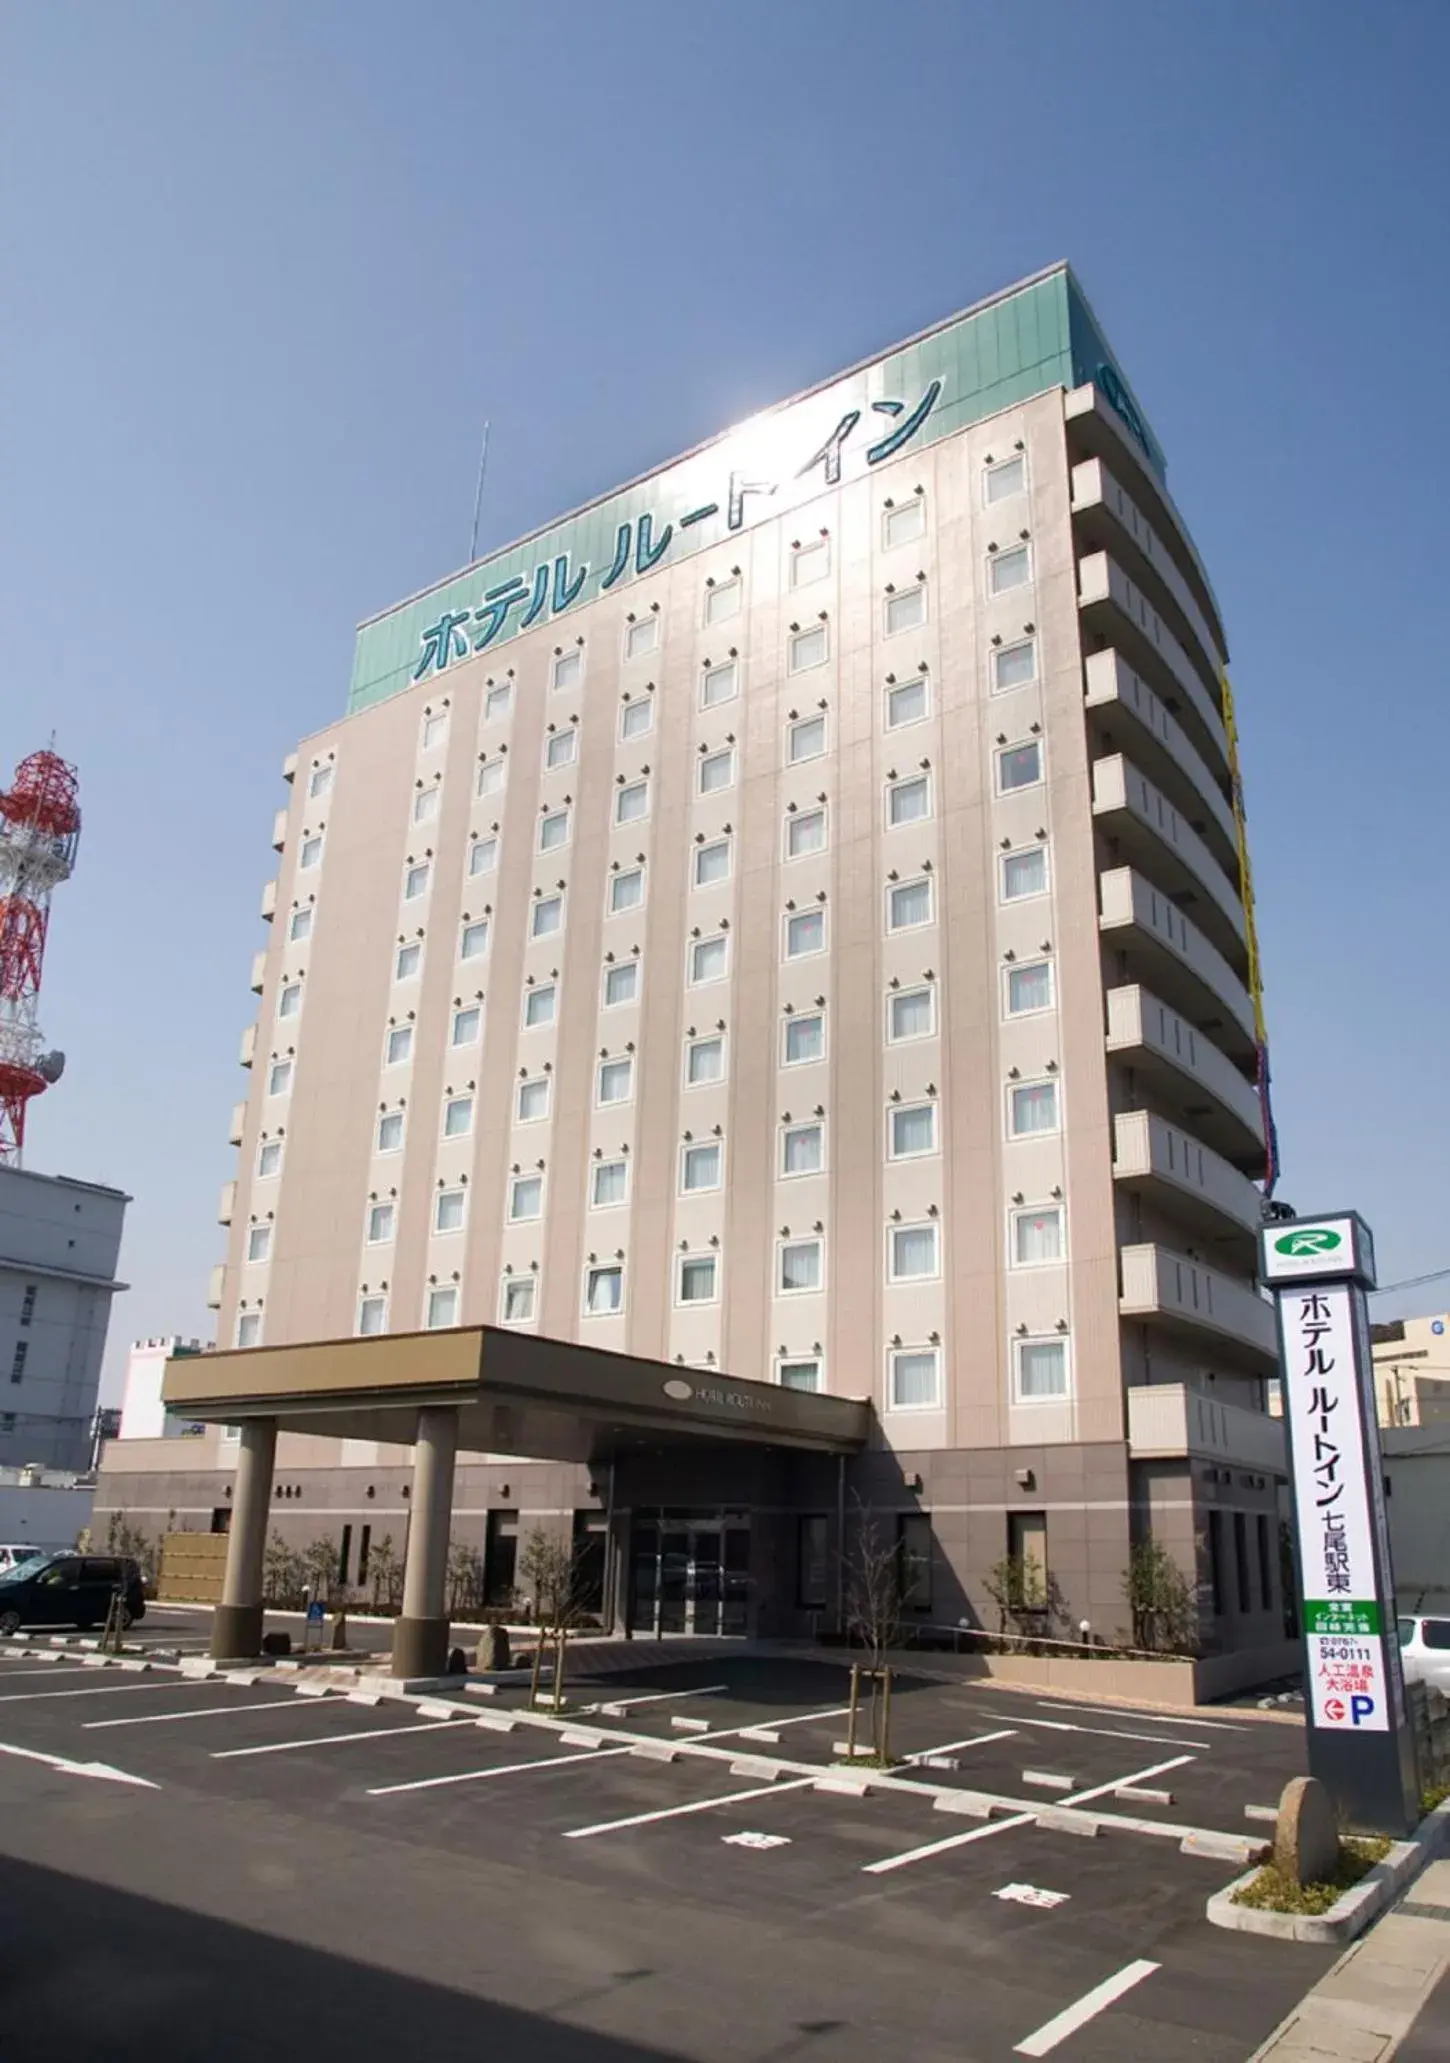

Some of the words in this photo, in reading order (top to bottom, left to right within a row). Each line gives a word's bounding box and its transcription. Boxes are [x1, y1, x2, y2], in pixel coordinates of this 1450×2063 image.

[412, 554, 588, 683] ホテル
[600, 379, 945, 590] ルートイン
[1299, 1294, 1335, 1376] ホテル
[1320, 1646, 1370, 1660] 54-0111
[1351, 1695, 1375, 1726] P
